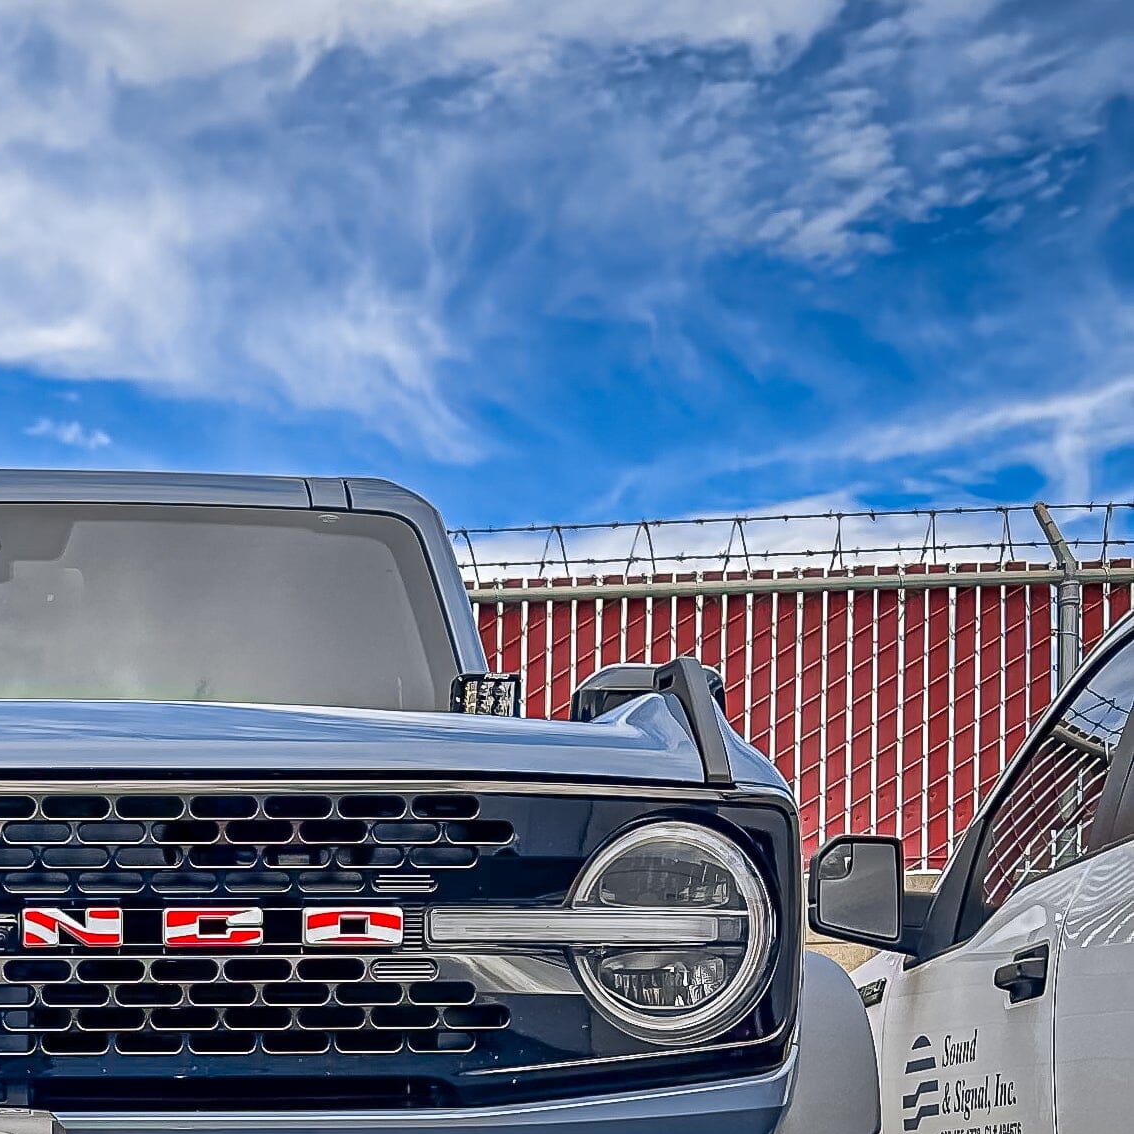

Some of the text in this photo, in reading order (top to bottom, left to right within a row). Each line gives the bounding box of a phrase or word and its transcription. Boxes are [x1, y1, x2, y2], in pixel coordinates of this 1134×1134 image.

[942, 1029, 978, 1068] Sound
[942, 1074, 1017, 1120] & Signal, Inc.
